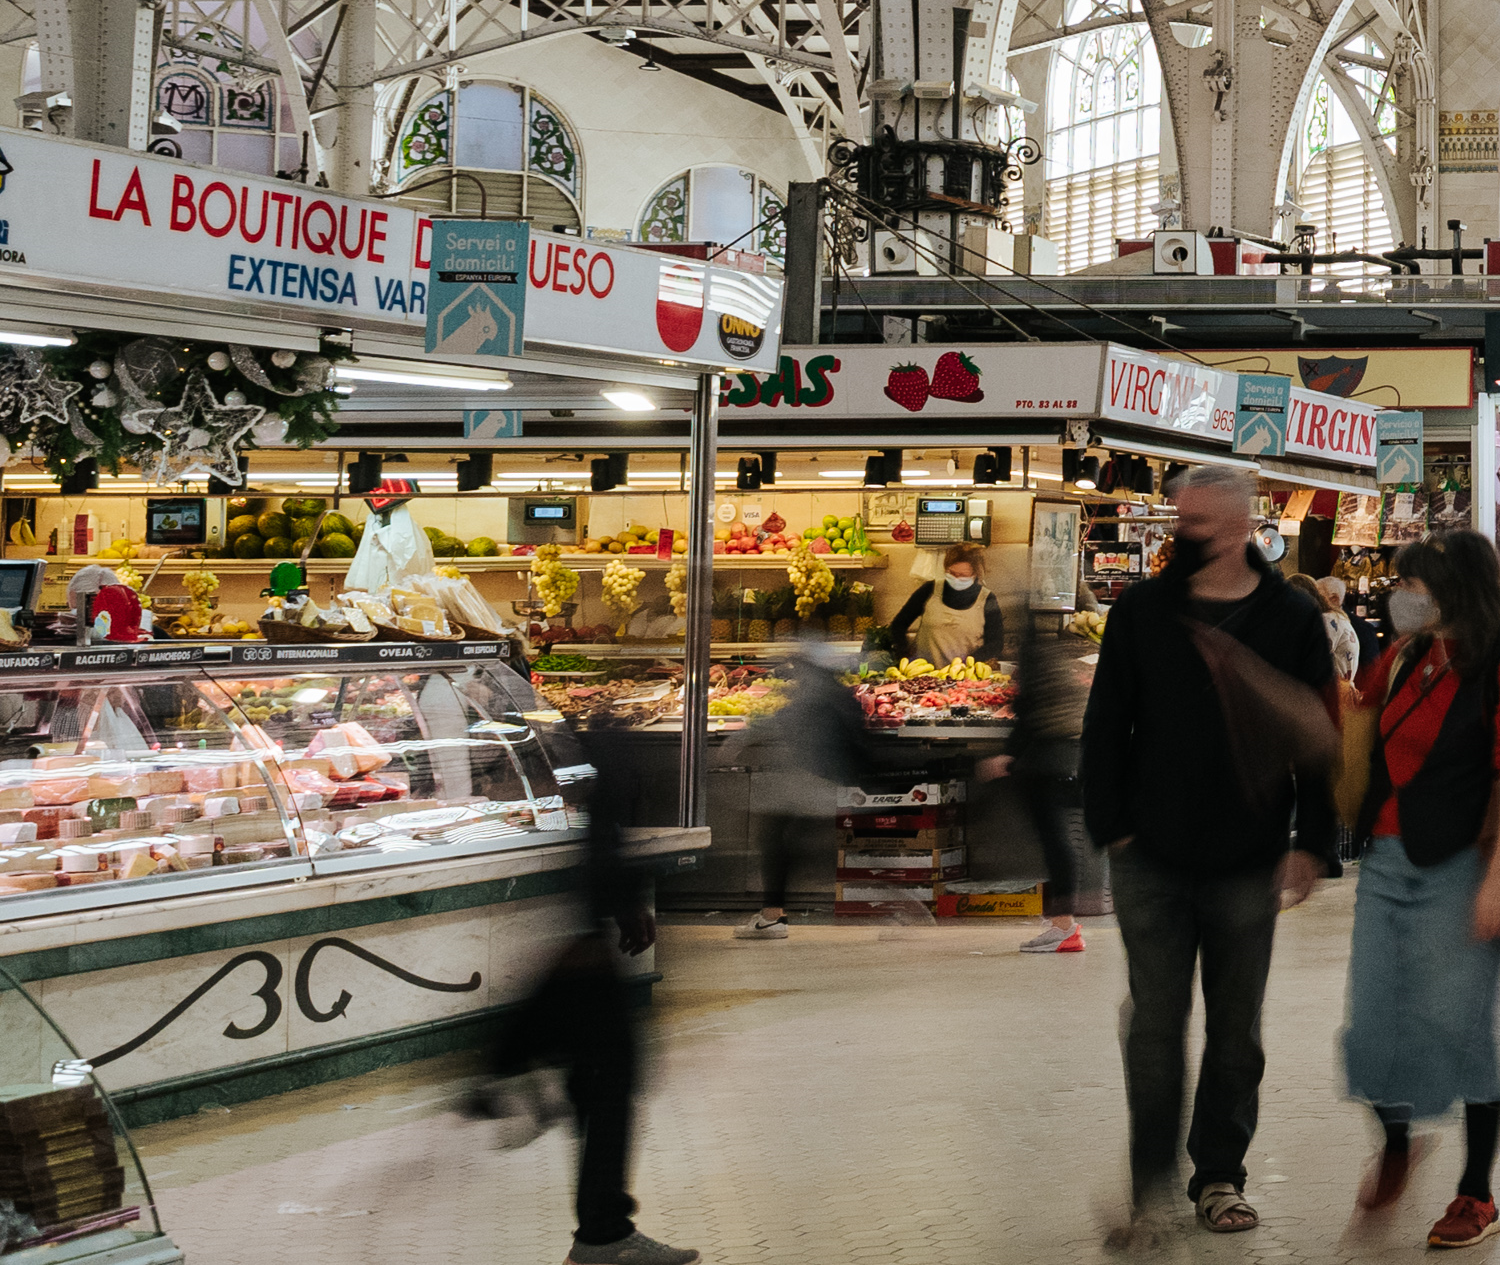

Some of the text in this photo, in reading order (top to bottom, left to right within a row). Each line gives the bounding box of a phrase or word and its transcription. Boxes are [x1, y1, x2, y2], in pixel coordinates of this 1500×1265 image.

[89, 158, 152, 227] LA
[169, 174, 388, 264] BOUTIQUE
[528, 240, 615, 299] UESO
[446, 233, 516, 251] Servei a
[444, 253, 514, 271] domicili
[228, 254, 426, 317] EXTENSA VAR
[1244, 382, 1275, 394] Servei
[1015, 400, 1078, 409] PTO. 83 AL 88
[1243, 395, 1283, 407] domicili
[149, 651, 191, 662] MANCHEGOS
[276, 649, 339, 659] INTERNACIONALES
[379, 648, 413, 658] OVEJA
[75, 654, 116, 665] RACLETTE
